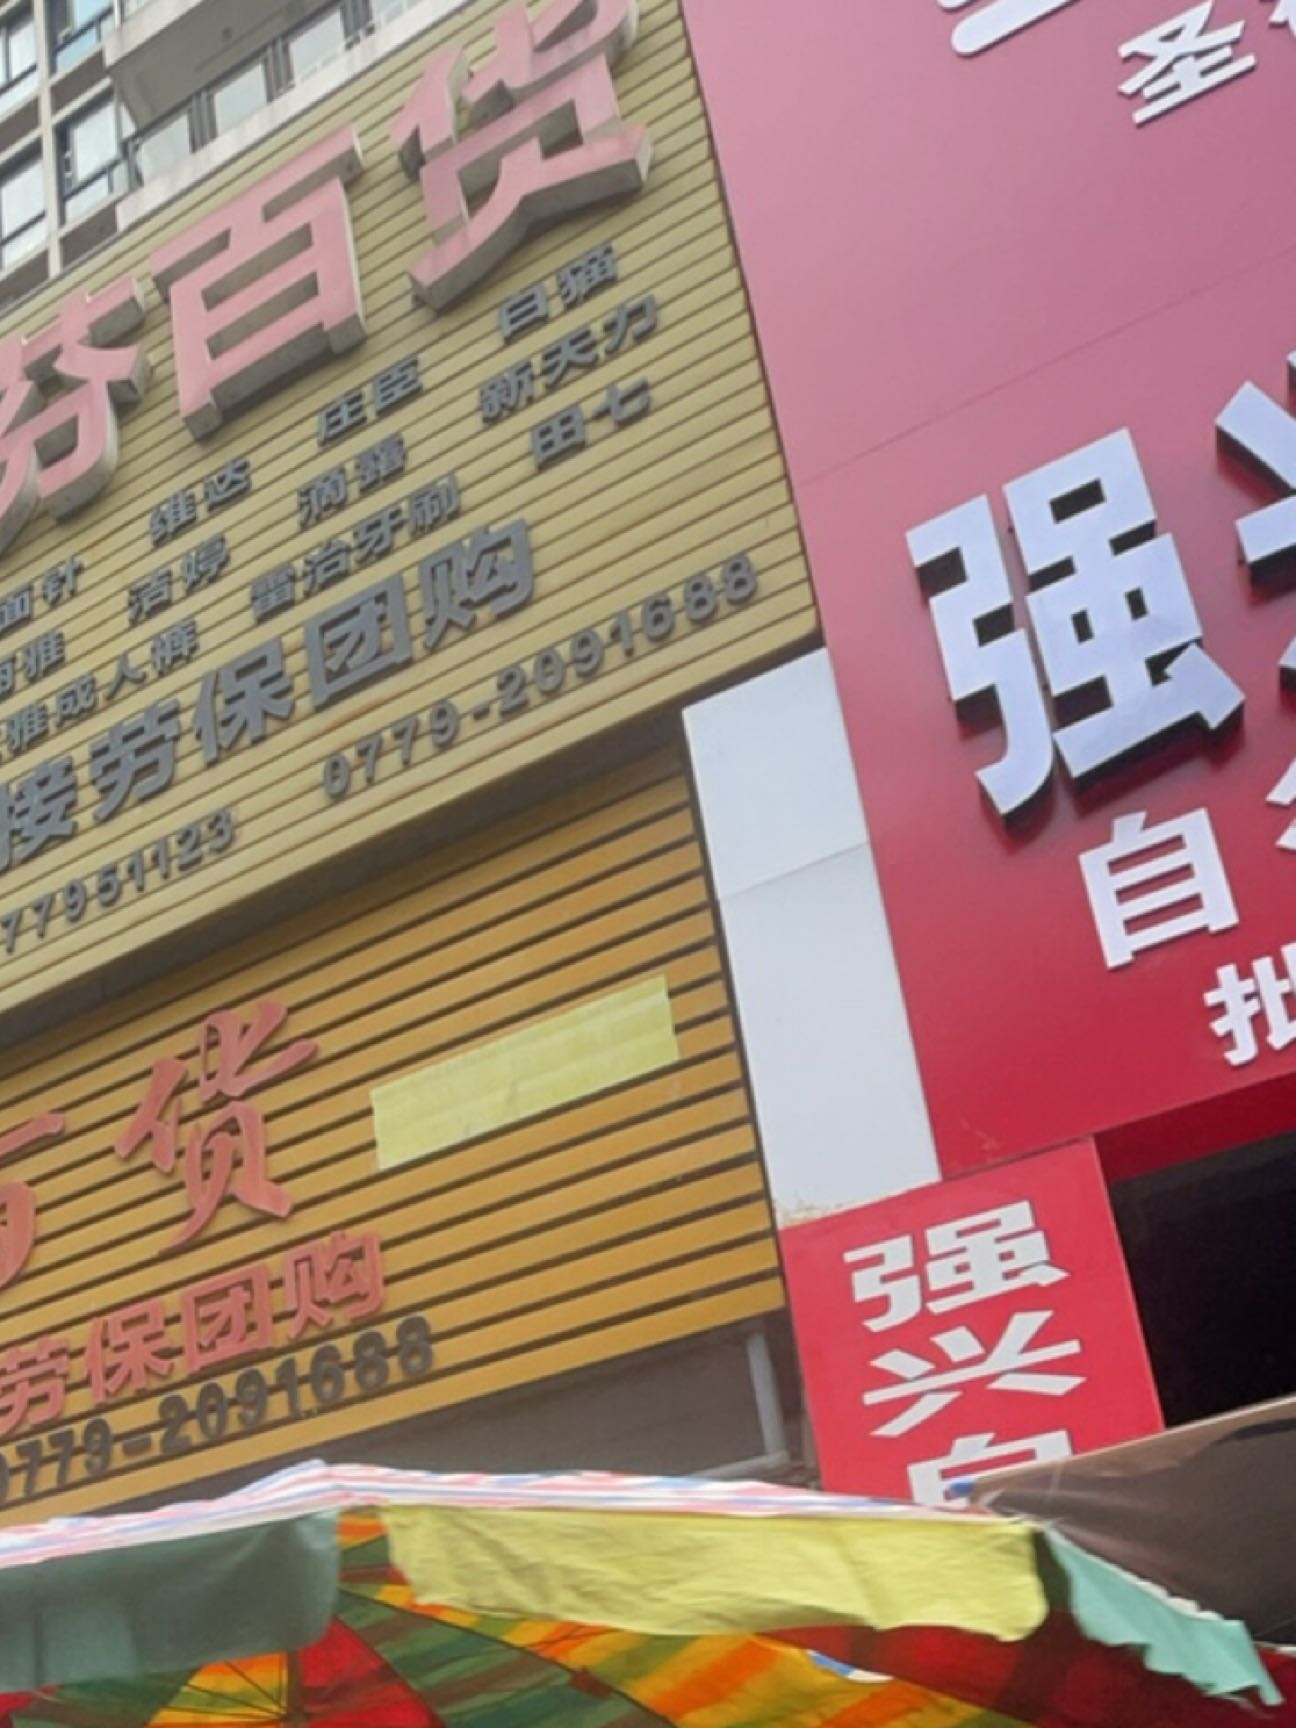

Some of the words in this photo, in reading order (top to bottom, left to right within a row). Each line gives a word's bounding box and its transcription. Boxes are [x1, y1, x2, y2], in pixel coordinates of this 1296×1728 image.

[1118, 0, 1296, 125] 圣
[128, 533, 231, 627] 洁婷
[297, 431, 408, 531] 滴露
[478, 294, 659, 425] 新天力
[150, 456, 251, 547] 维达
[317, 355, 424, 447] 庄臣
[498, 241, 618, 345] 白猫
[531, 377, 652, 472] 田七
[322, 554, 759, 799] 0779-2091688
[906, 352, 1296, 826] 强
[1079, 762, 1296, 969] 自
